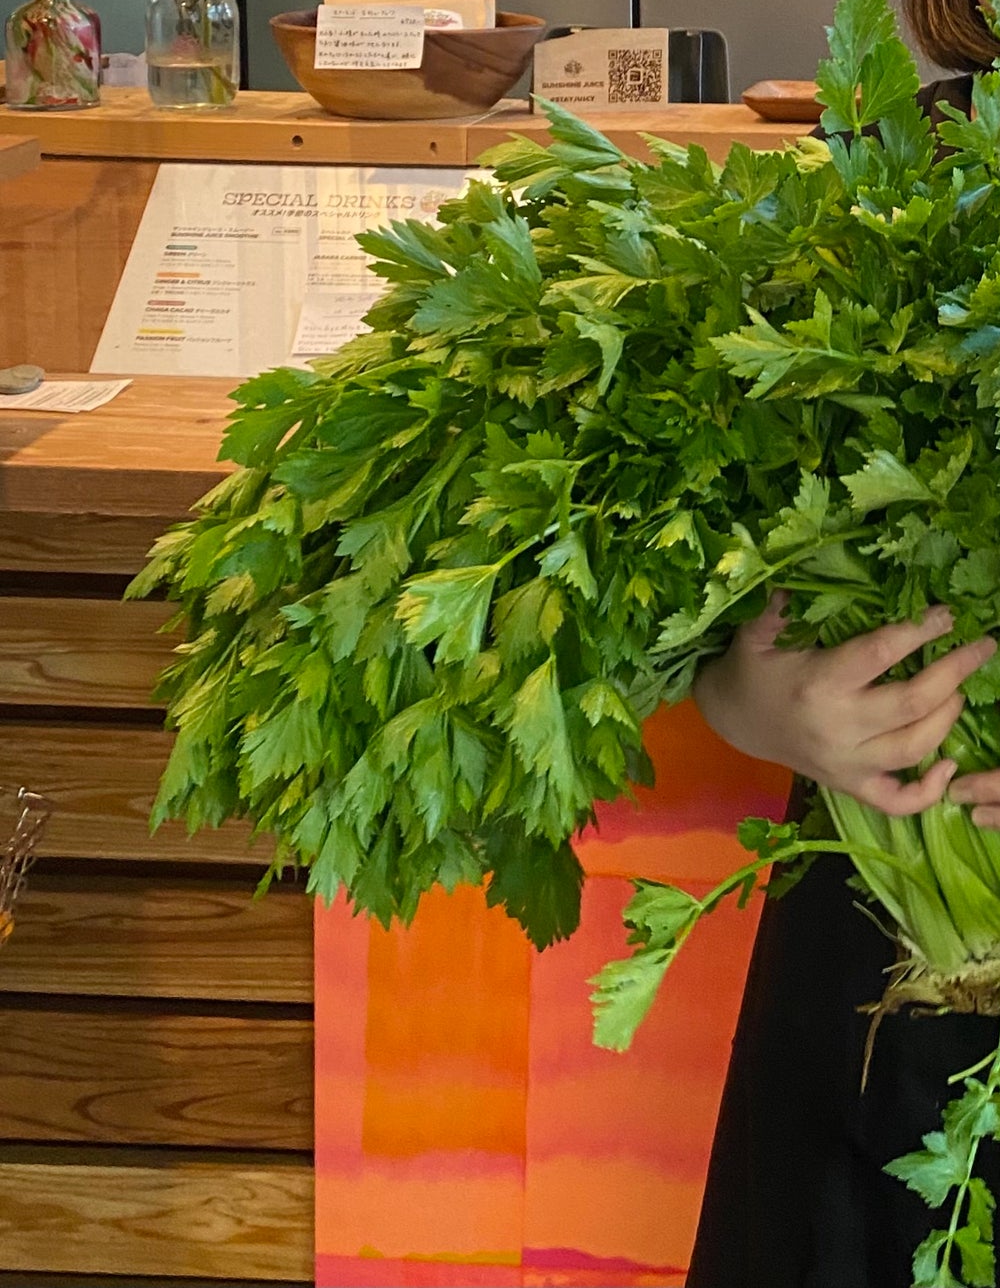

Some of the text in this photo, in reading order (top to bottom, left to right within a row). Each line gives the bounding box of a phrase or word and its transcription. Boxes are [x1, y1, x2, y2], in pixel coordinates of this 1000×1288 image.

[541, 80, 605, 89] SUNSHINE JUICE
[222, 192, 417, 210] SPECIAL DRINKS
